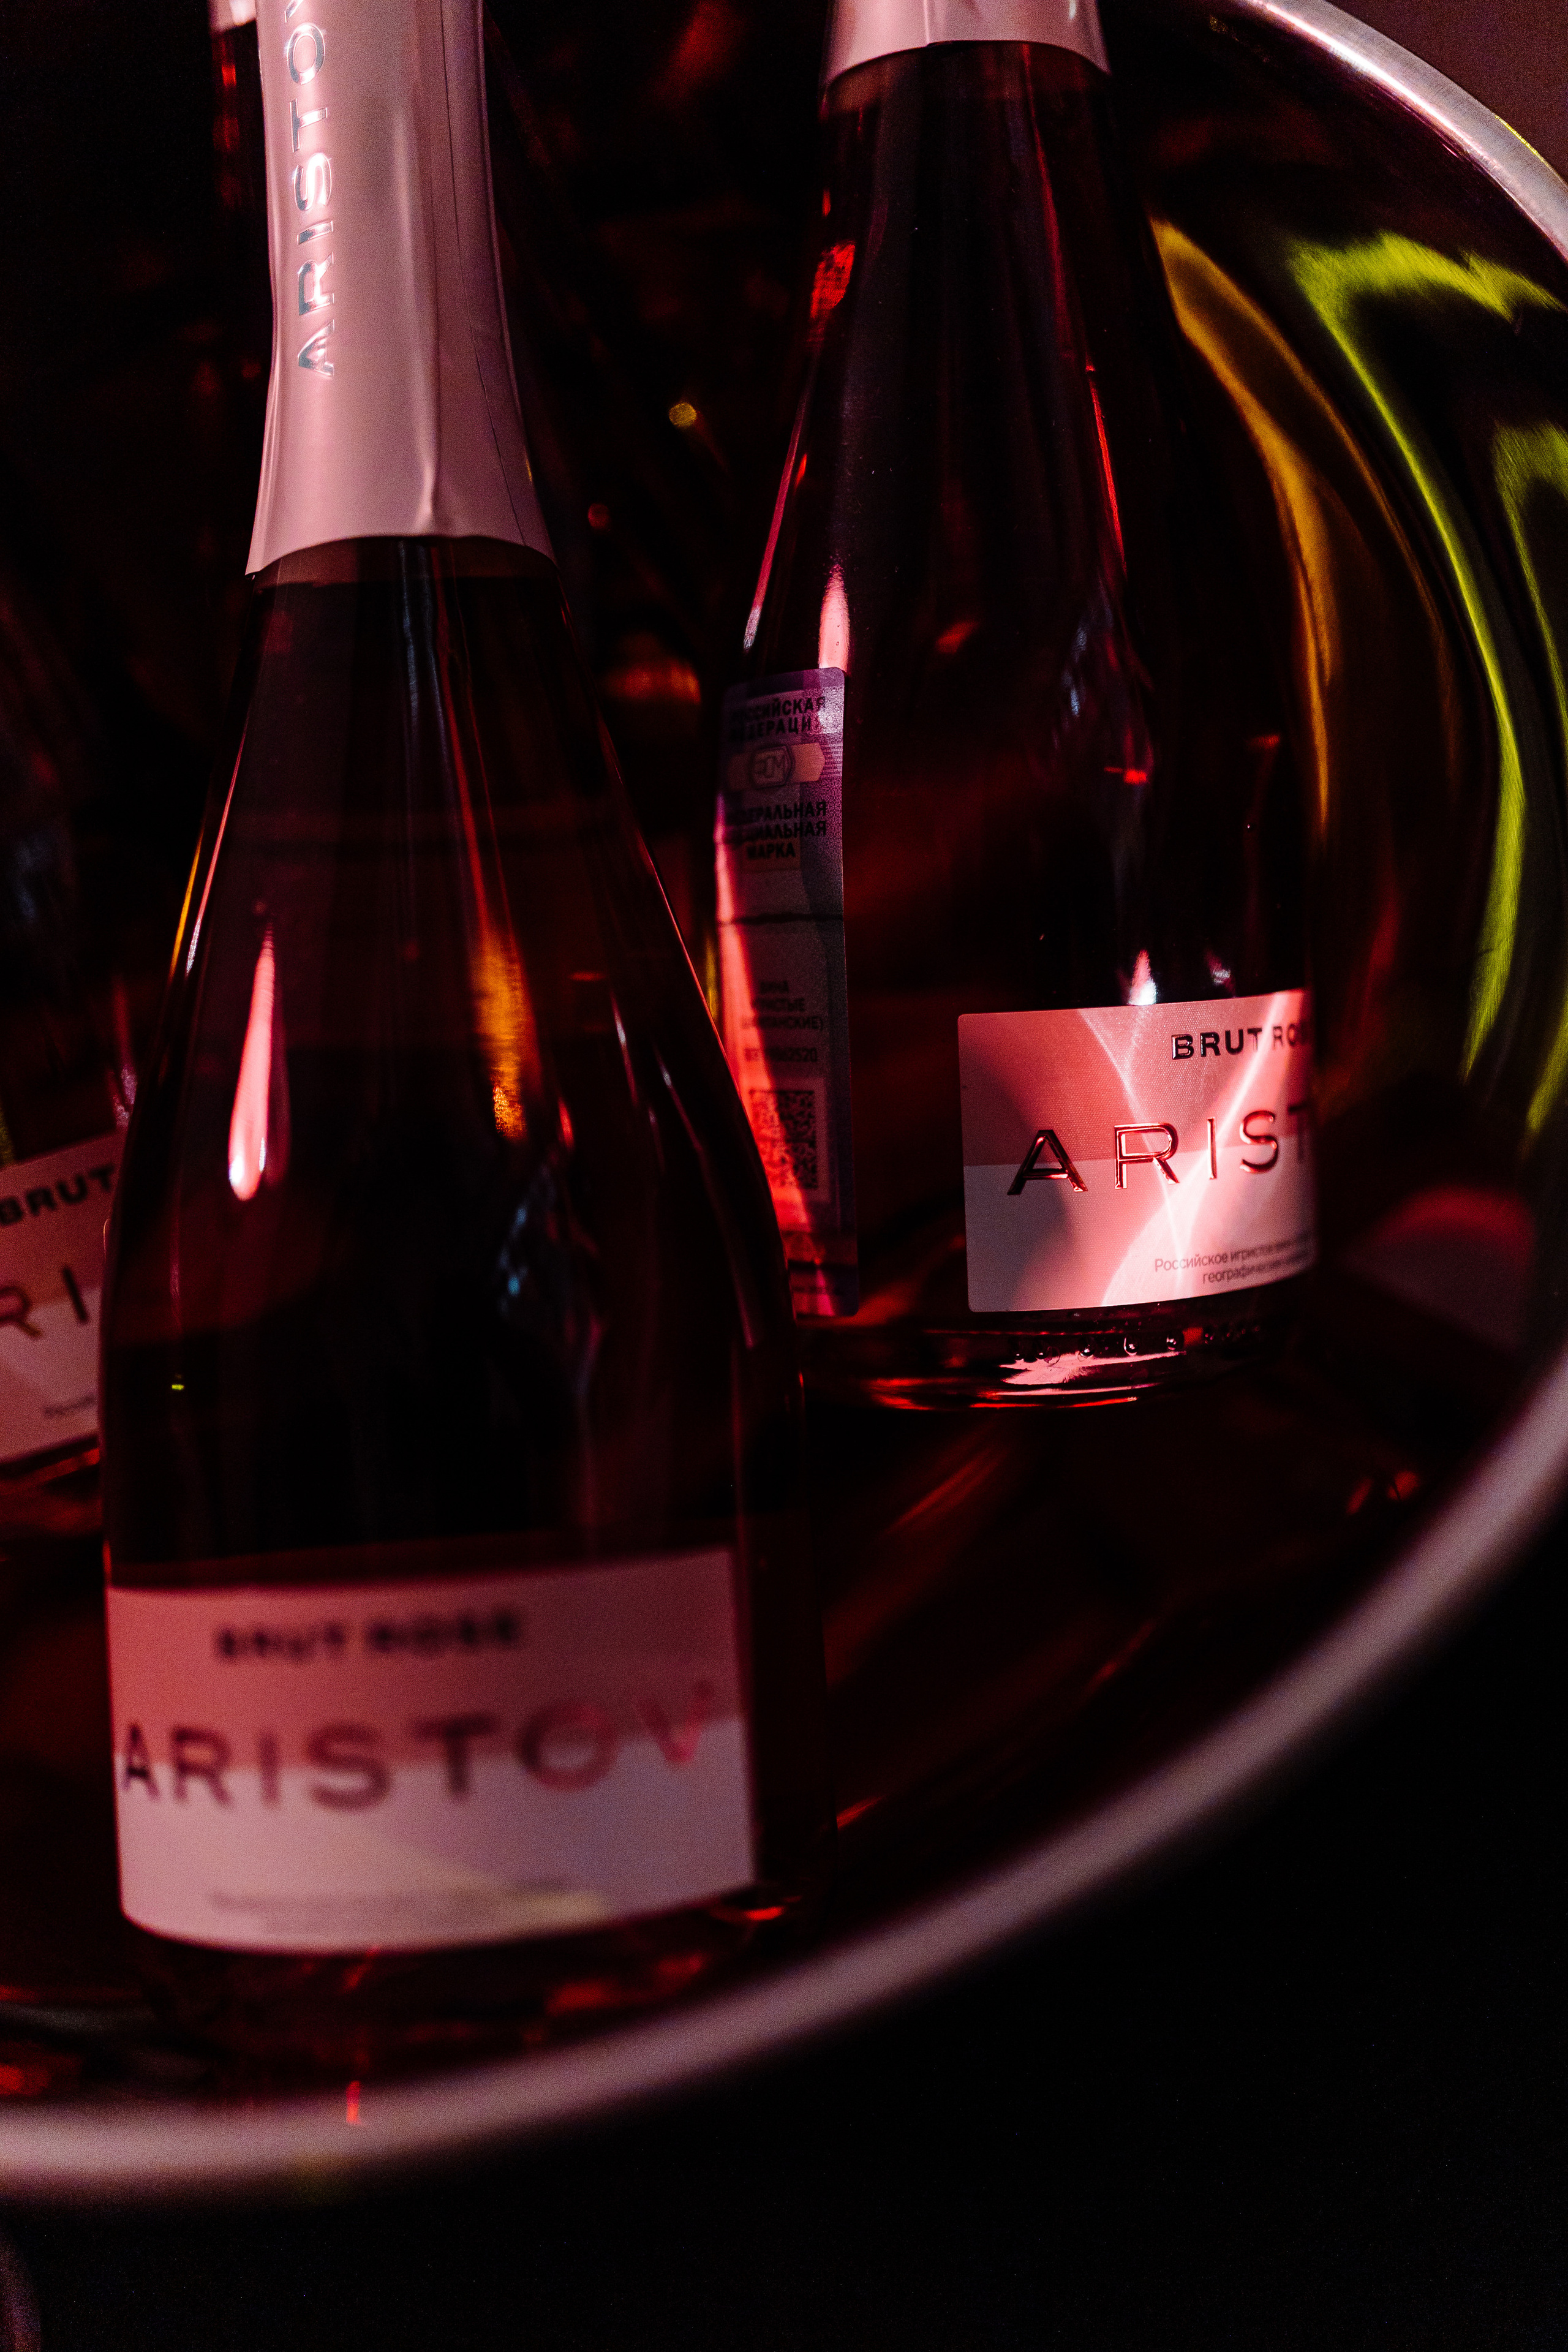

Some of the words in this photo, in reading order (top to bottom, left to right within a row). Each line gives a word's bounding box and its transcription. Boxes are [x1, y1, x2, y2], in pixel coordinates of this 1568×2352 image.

[726, 801, 826, 823] РАЛЬНАЯ
[728, 820, 826, 846] ИАЛЬНАЯ
[1170, 1027, 1263, 1060] BRUT
[1155, 1253, 1228, 1273] Российское
[123, 1681, 717, 1809] ARISTOV
